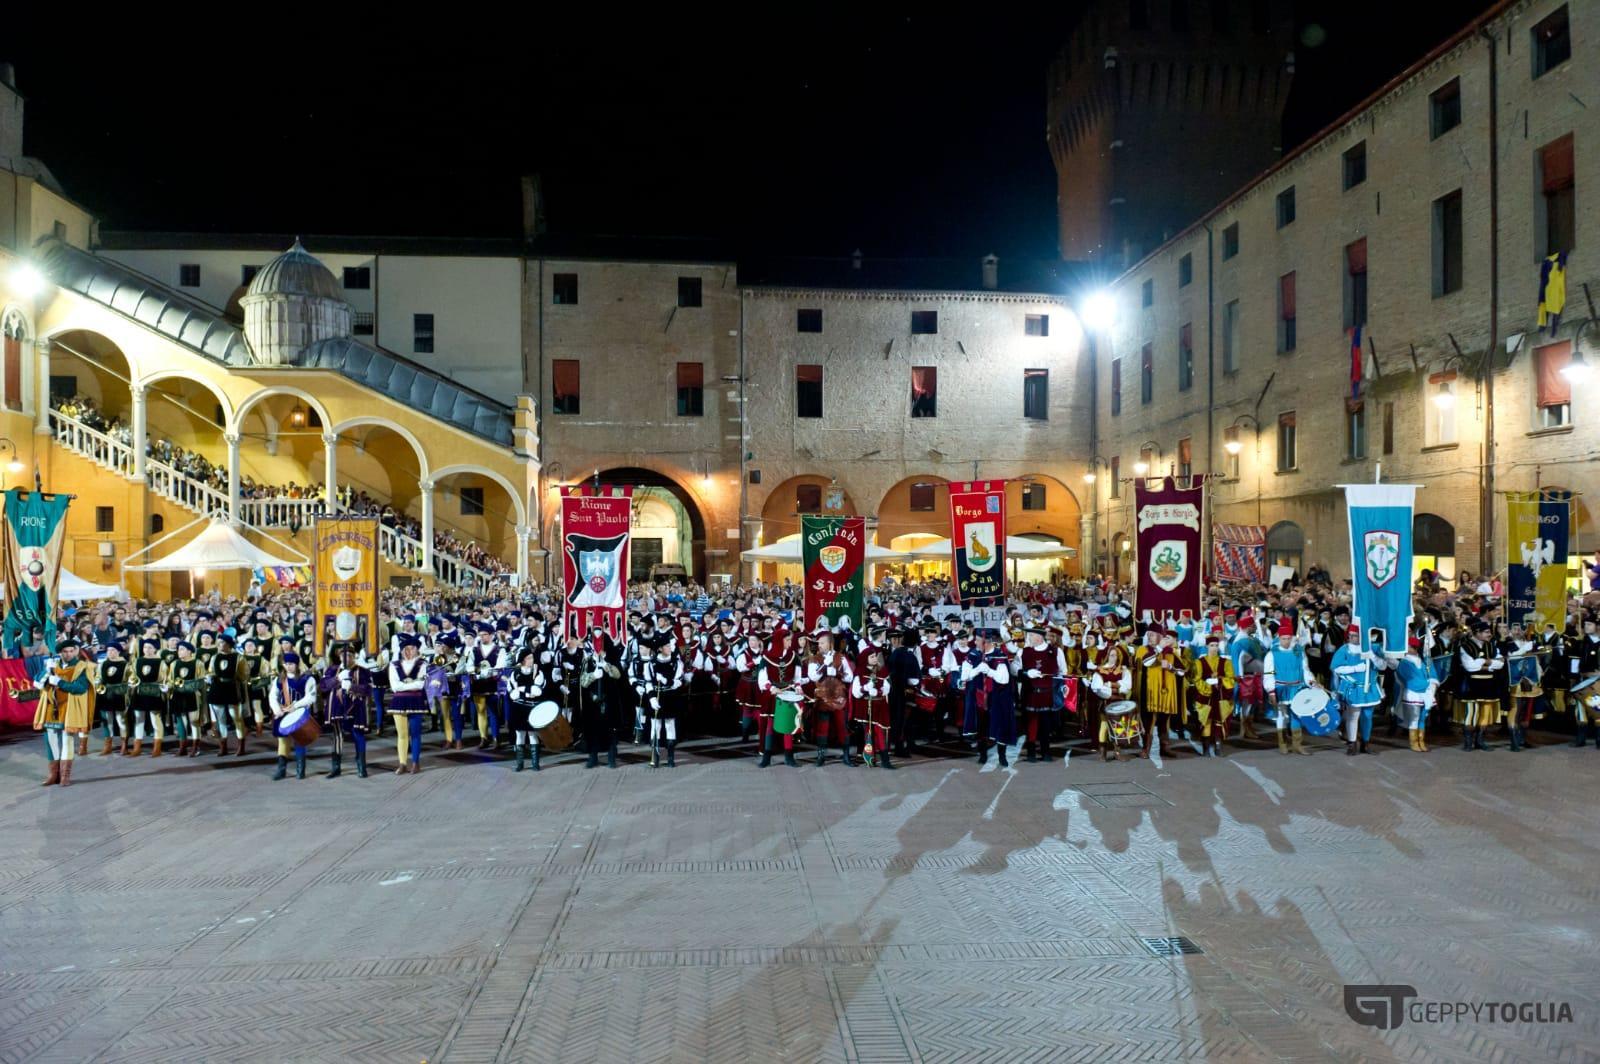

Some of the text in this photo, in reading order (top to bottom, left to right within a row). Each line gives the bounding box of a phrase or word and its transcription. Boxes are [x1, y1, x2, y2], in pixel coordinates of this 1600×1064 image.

[579, 497, 612, 511] Rione
[567, 511, 628, 526] San Paolo
[954, 505, 982, 519] Borgo
[20, 516, 47, 529] RIONE
[808, 524, 858, 546] Contrada
[970, 572, 993, 584] San
[827, 580, 855, 594] Luca
[818, 598, 850, 609] Ferrara
